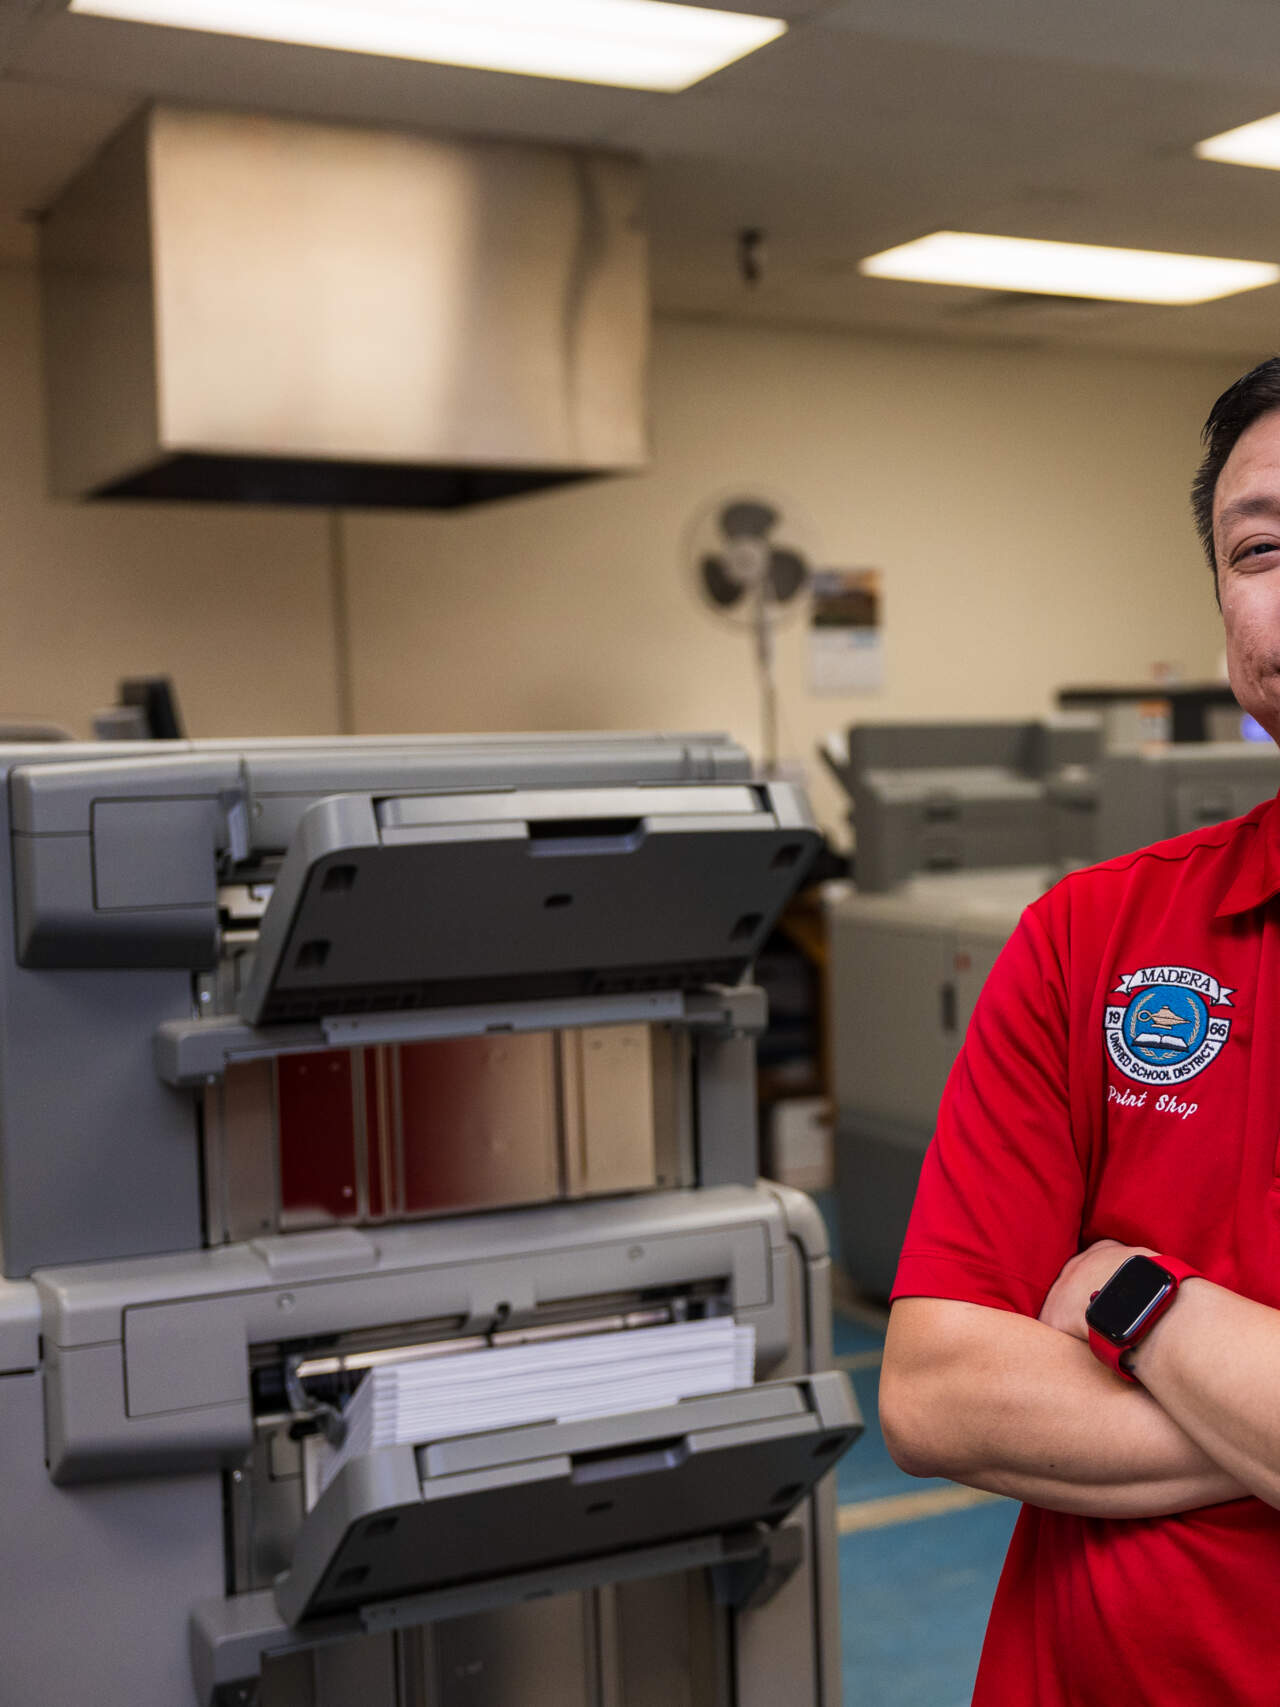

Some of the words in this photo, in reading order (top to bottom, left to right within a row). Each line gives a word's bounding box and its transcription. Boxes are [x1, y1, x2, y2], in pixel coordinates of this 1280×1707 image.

[1140, 969, 1211, 992] MADERA
[1108, 1010, 1121, 1024] 19
[1209, 1022, 1227, 1037] 66
[1109, 1032, 1132, 1067] UNIFIED
[1129, 1062, 1172, 1081] SCHOOL
[1173, 1043, 1215, 1079] DISTRICT
[1107, 1085, 1148, 1107] Print
[1155, 1094, 1198, 1120] Shop
